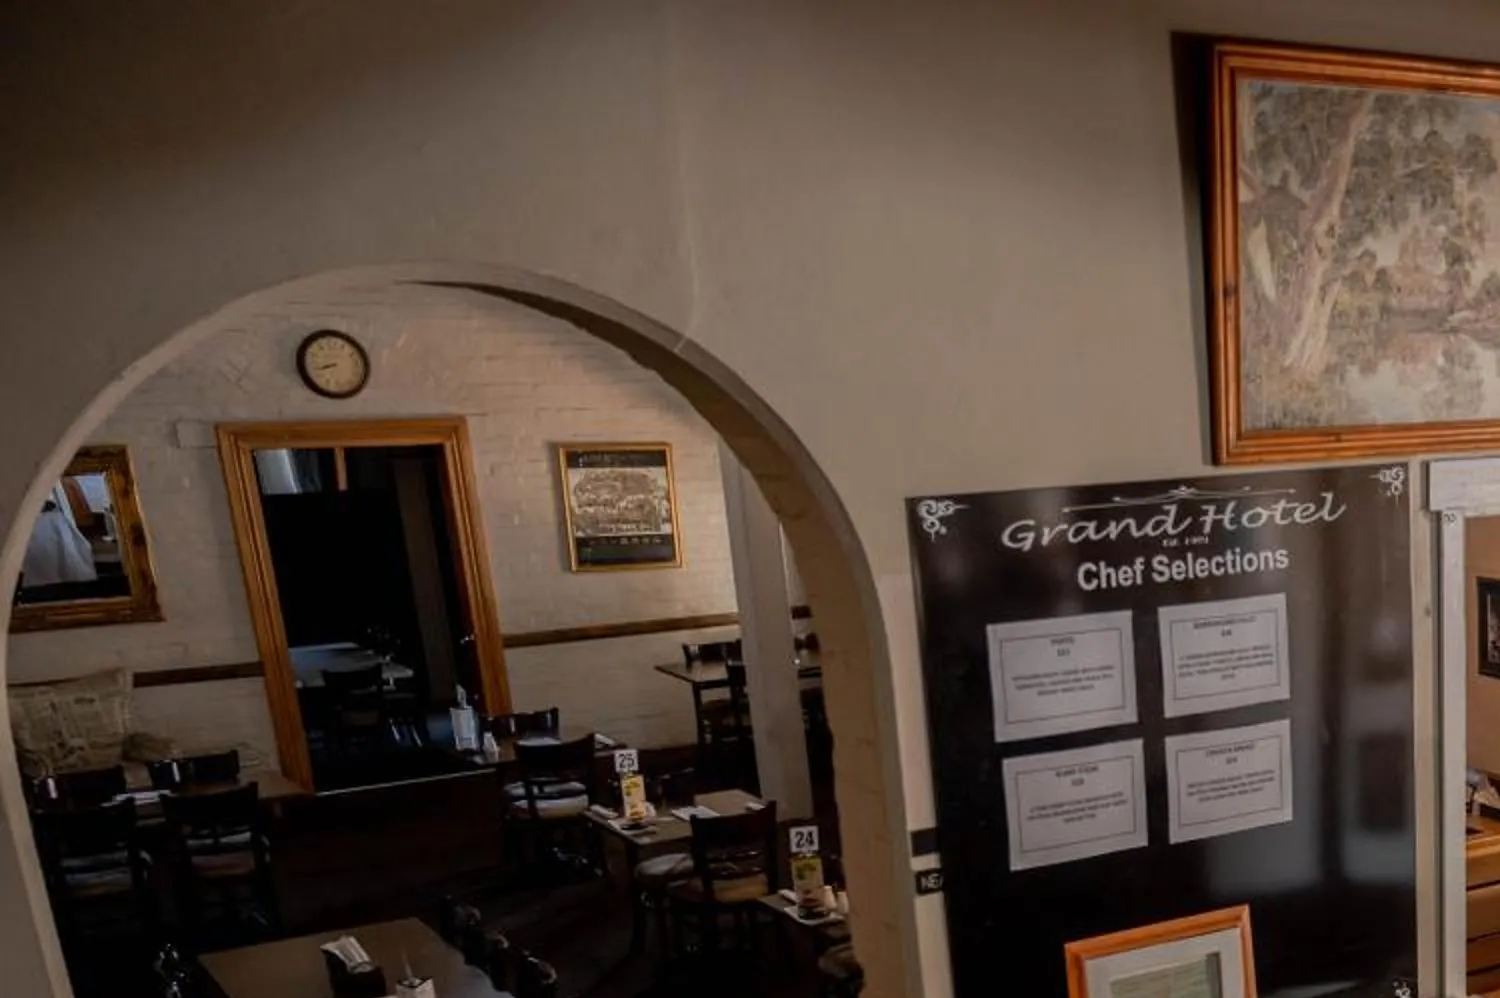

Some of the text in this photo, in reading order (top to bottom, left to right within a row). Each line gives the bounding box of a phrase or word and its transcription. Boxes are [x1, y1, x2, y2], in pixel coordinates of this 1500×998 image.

[1001, 492, 1347, 551] Grand Hotel
[1077, 548, 1291, 592] Chef Selections
[619, 753, 635, 769] 25
[794, 830, 815, 849] 24
